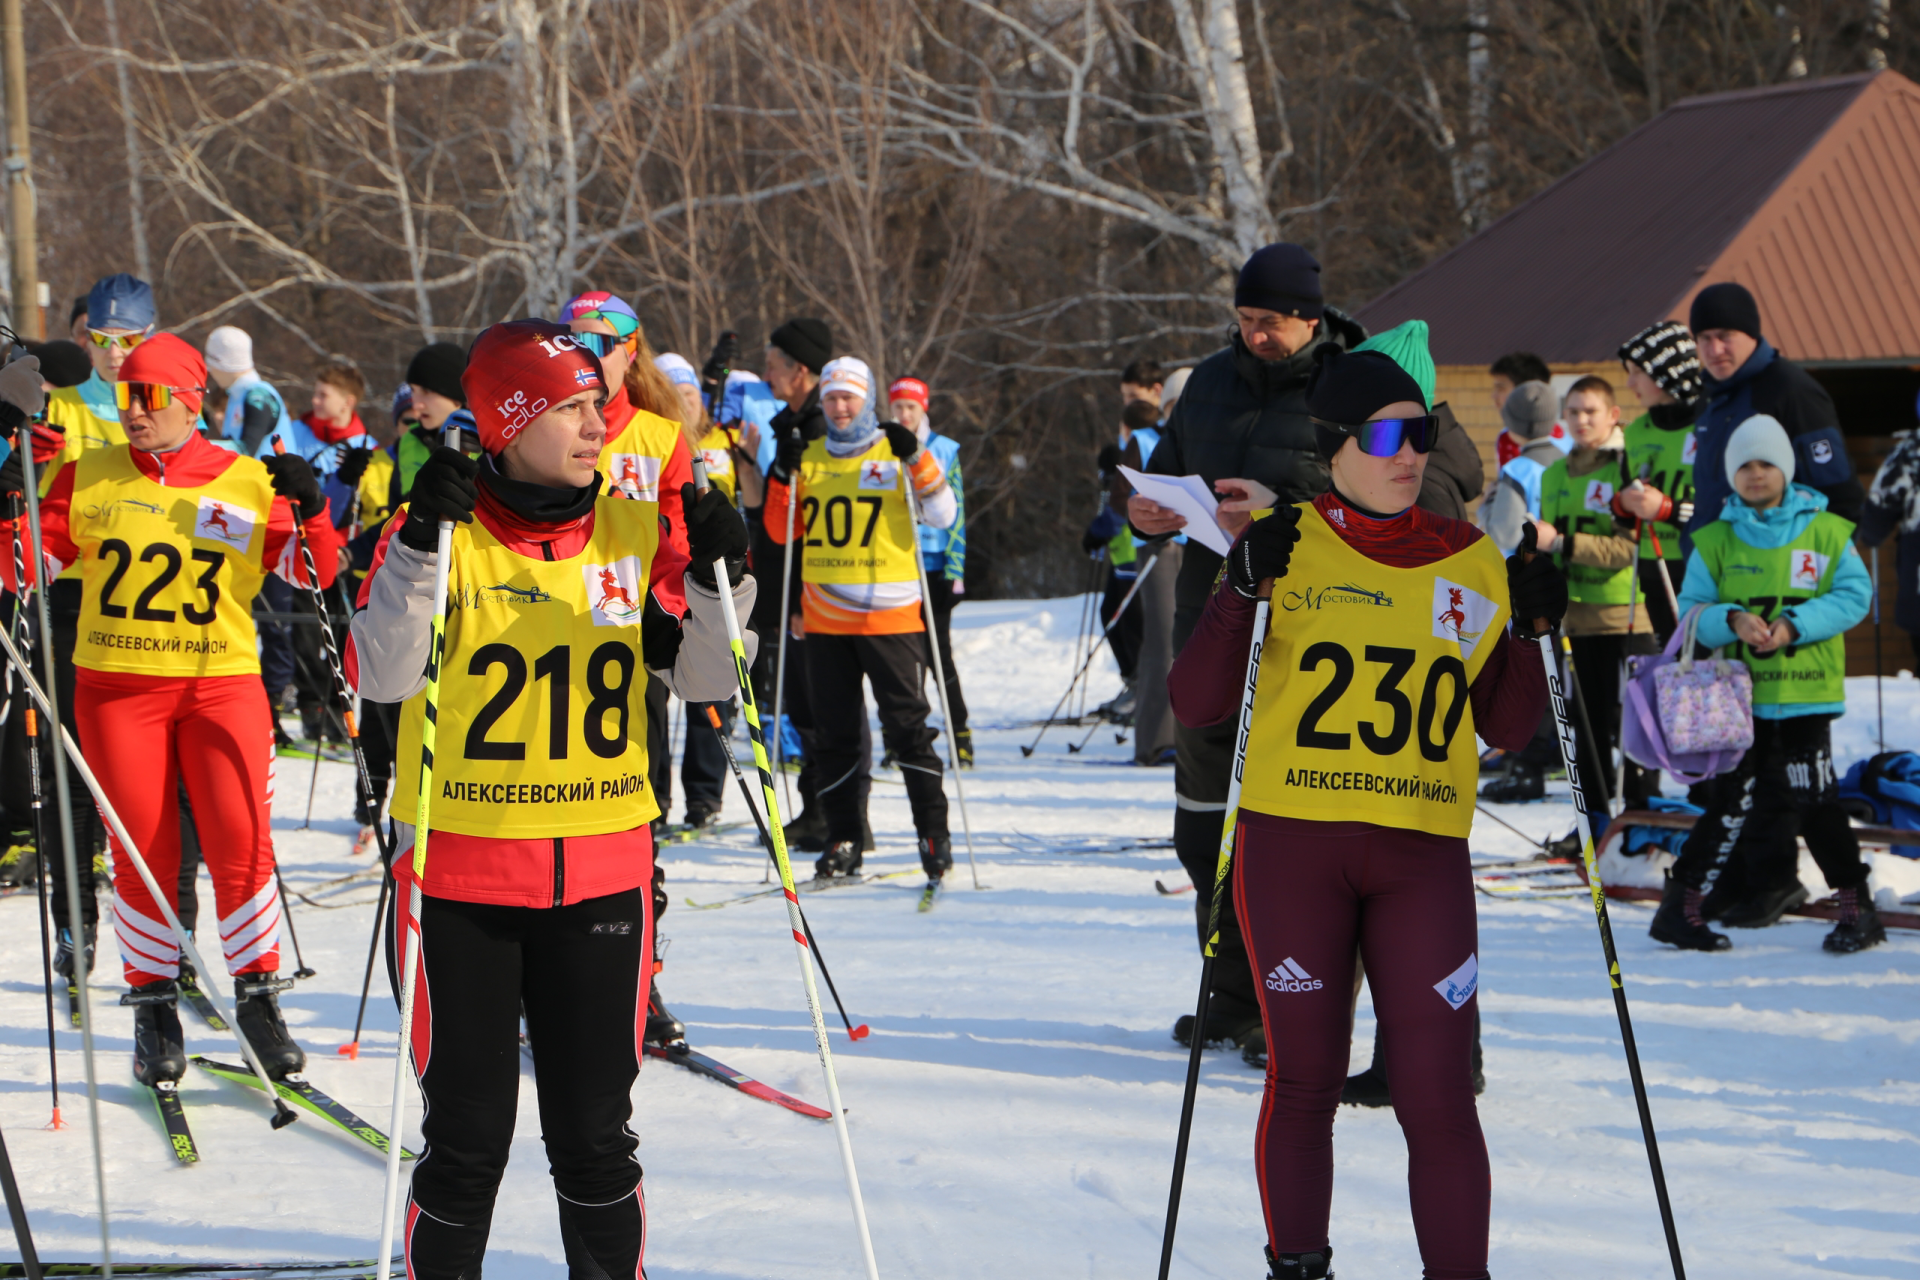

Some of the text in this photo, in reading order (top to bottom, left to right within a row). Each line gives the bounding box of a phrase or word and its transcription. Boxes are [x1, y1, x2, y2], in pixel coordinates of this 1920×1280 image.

[539, 334, 588, 358] ice
[497, 390, 528, 419] ice
[501, 397, 548, 439] odlo
[802, 495, 882, 548] 207
[98, 538, 225, 625] 223
[87, 630, 227, 654] АЛЕКСЕЕВСКИЙ РАЙОН
[1791, 667, 1826, 681] РАЙОН
[463, 641, 635, 760] 218
[1296, 641, 1470, 762] 230
[1549, 674, 1588, 816] FISCHER
[443, 772, 644, 804] АЛЕКСЕЕВСКИЙ РАЙОН
[1285, 768, 1457, 804] АЛЕКСЕЕВСКИЙ РАЙОН
[1265, 977, 1324, 993] adidas
